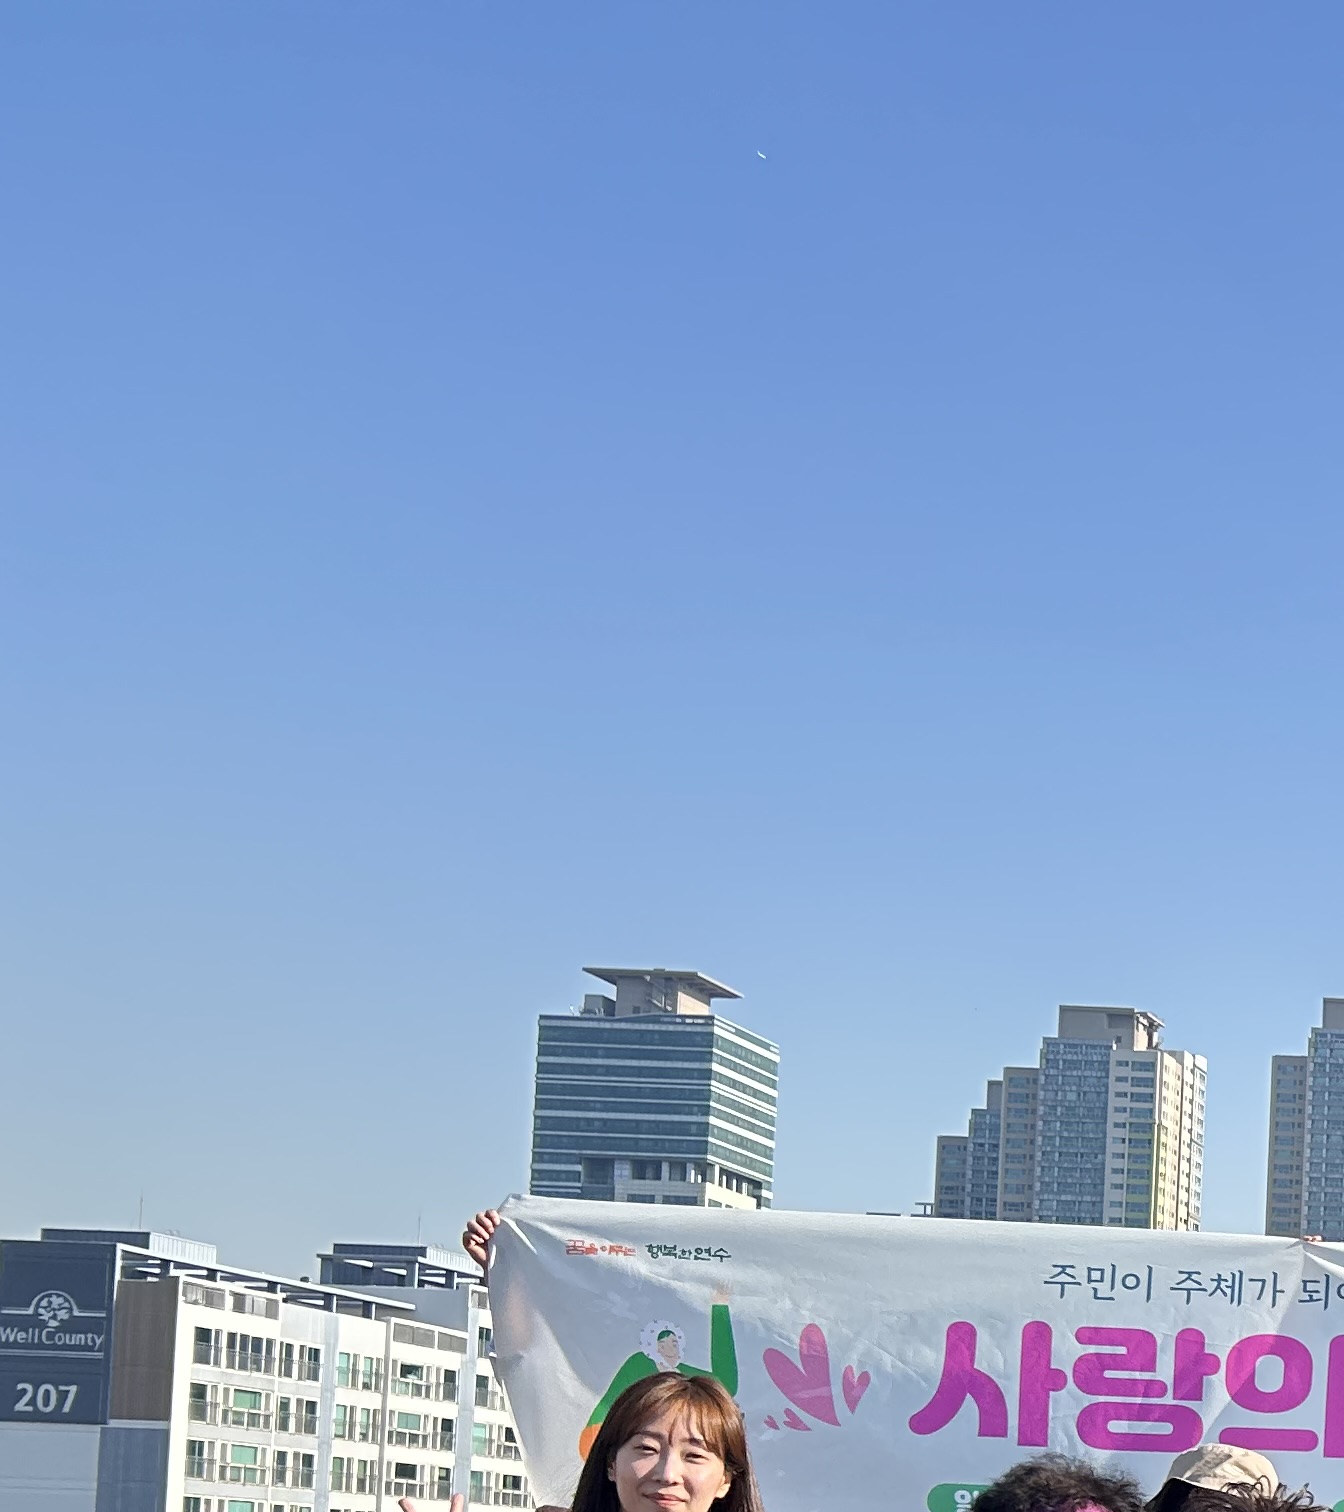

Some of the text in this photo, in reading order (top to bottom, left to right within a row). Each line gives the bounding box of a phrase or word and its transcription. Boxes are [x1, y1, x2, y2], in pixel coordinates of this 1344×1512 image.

[1043, 1263, 1153, 1302] 주민이
[1169, 1269, 1286, 1308] 주체가
[0, 1327, 105, 1351] Well County
[14, 1383, 78, 1413] 207
